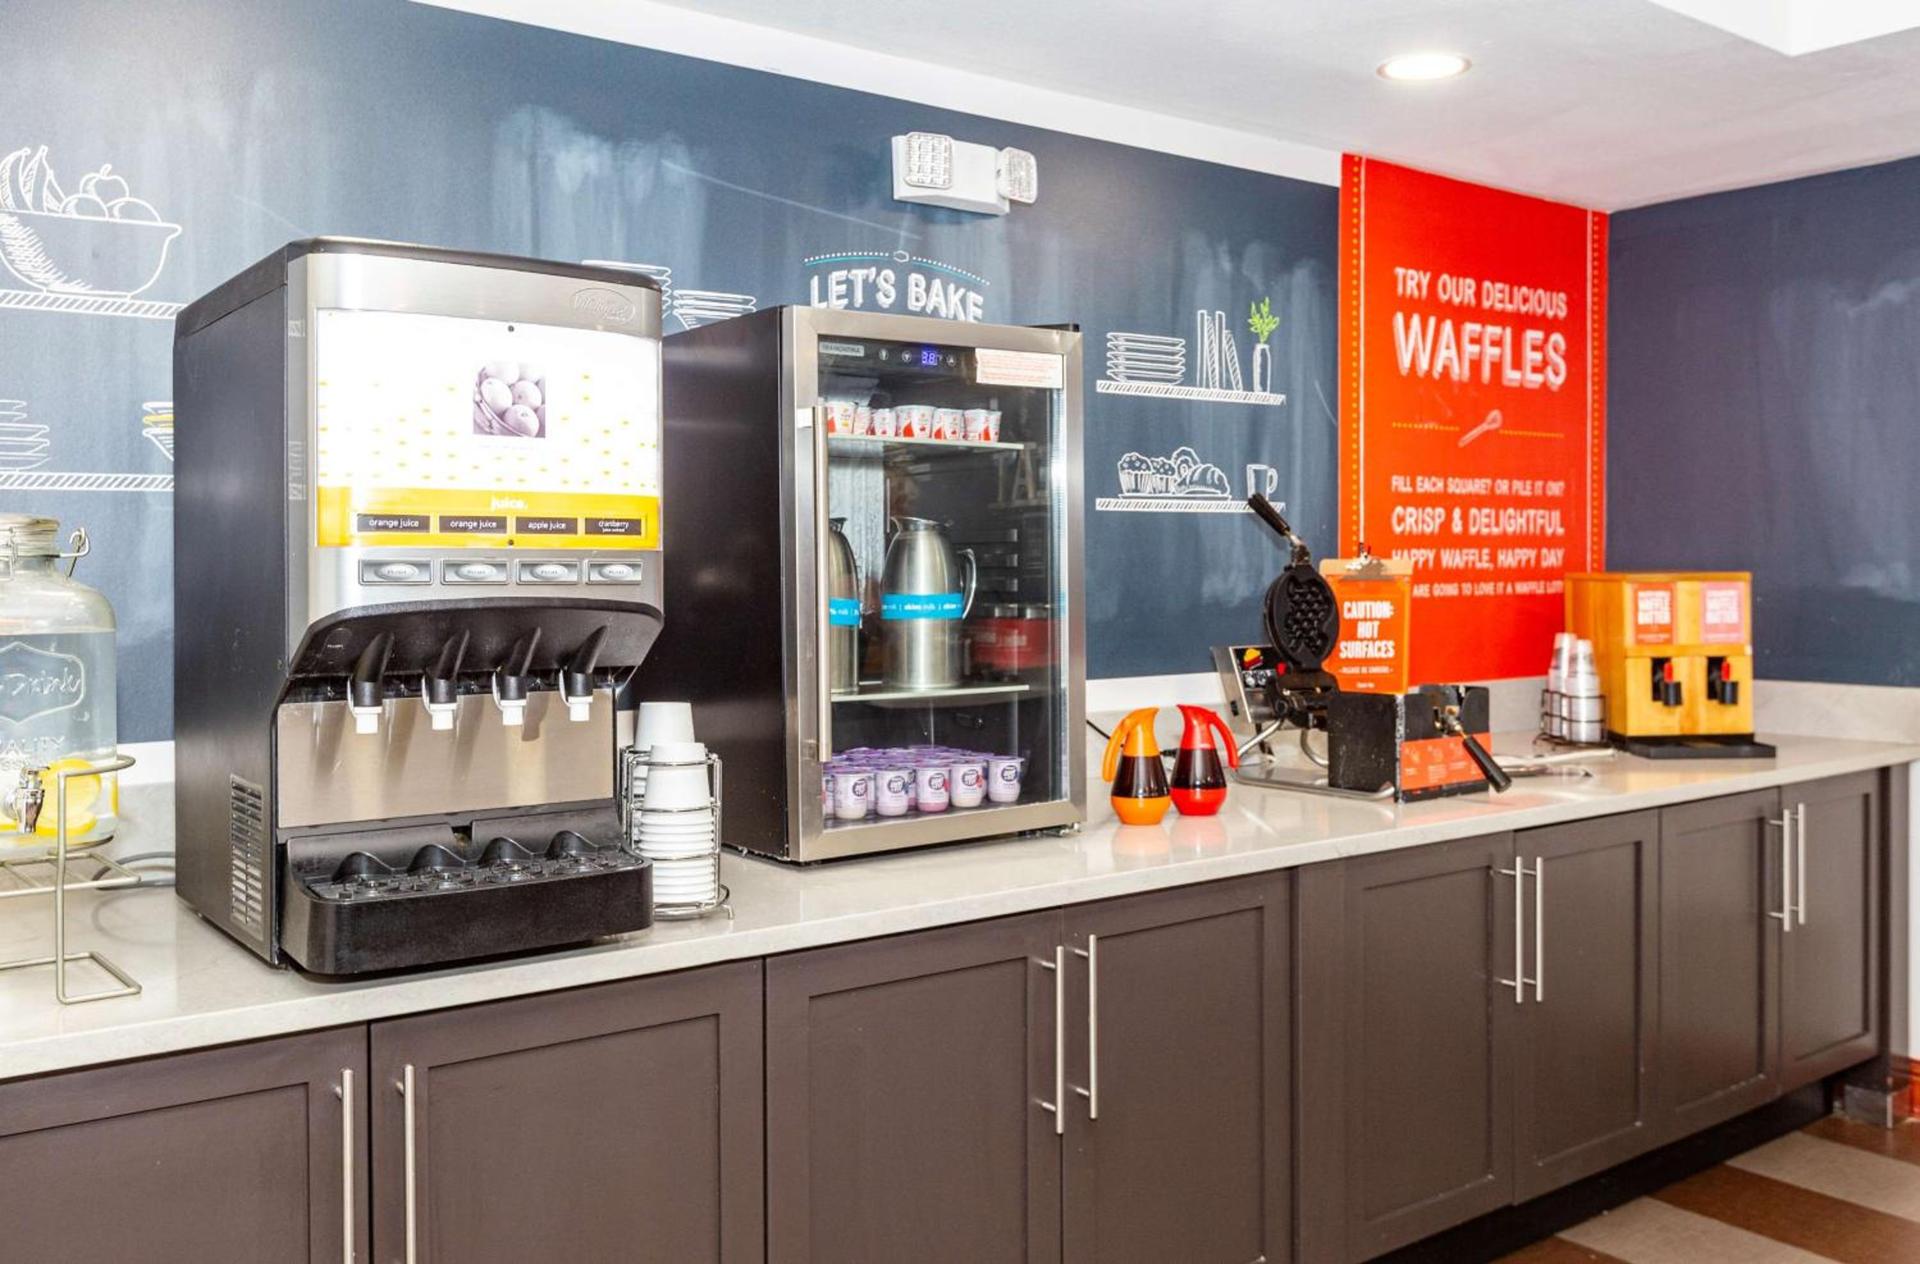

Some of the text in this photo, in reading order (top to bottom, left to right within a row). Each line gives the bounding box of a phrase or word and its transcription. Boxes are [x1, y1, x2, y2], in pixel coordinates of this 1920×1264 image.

[810, 267, 985, 324] LET'S BAKE
[1394, 266, 1568, 320] TRY OUR DELICIOUS
[1392, 311, 1568, 392] WAFFLES
[1391, 475, 1413, 493] FILL
[1416, 476, 1445, 494] EACH
[1447, 476, 1493, 495] SQUARE?
[1494, 478, 1509, 495] OR
[1511, 479, 1533, 497] PILE
[1534, 480, 1544, 497] IT
[368, 518, 420, 530] orange juice
[449, 519, 498, 530] orange juice
[527, 520, 567, 531] apple juice
[598, 519, 630, 529] cranberry
[1391, 506, 1565, 537] CRISP & DELIGHTFUL
[1440, 548, 1494, 571] WAFFLE,
[1497, 548, 1537, 569] HAPPY
[1540, 547, 1566, 569] DAY
[1412, 583, 1431, 598] ARE
[1432, 583, 1459, 597] GOING
[1461, 582, 1473, 597] TO
[1474, 581, 1496, 596] LOVE
[1496, 581, 1506, 595] IT
[1506, 581, 1514, 595] A
[1514, 580, 1545, 595] WAFFLE
[1357, 620, 1380, 639] HOT
[1339, 640, 1395, 659] SURFACES
